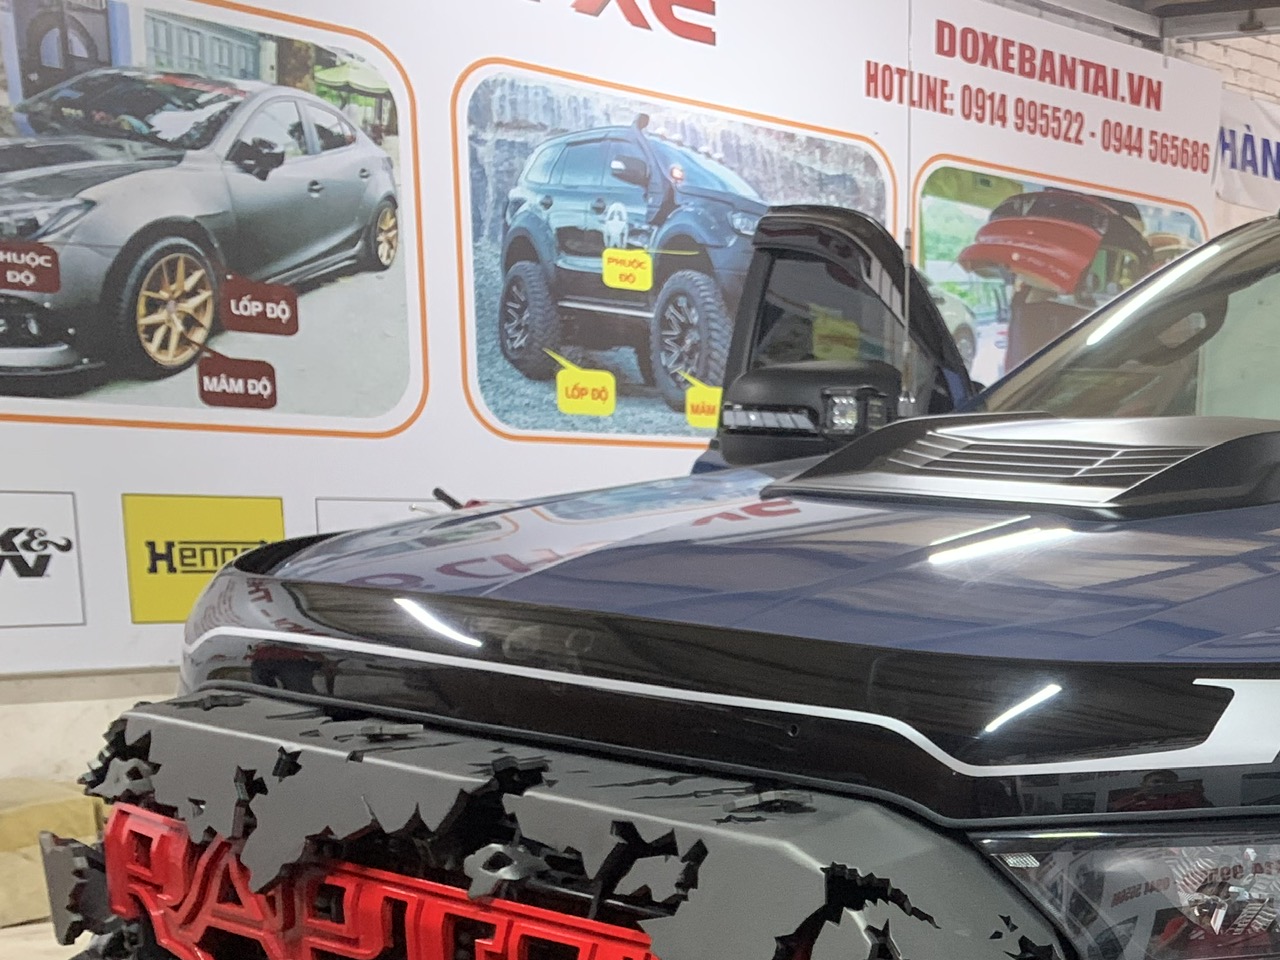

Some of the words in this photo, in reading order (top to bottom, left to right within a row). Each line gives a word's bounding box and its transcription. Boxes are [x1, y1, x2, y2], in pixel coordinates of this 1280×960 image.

[935, 19, 1162, 111] DOXEBANTAI.VN
[865, 60, 954, 116] HOTLINE:
[960, 84, 1007, 128] 0914
[1013, 97, 1084, 145] 995522
[1102, 119, 1143, 158] 0944
[1149, 130, 1210, 174] 565686
[6, 269, 36, 286] ĐỘ
[230, 295, 264, 317] LỐP
[265, 301, 291, 323] ĐỘ
[203, 373, 243, 395] MÂM
[247, 376, 272, 399] ĐỘ
[565, 382, 589, 401] LỐP
[591, 385, 609, 405] ĐỘ
